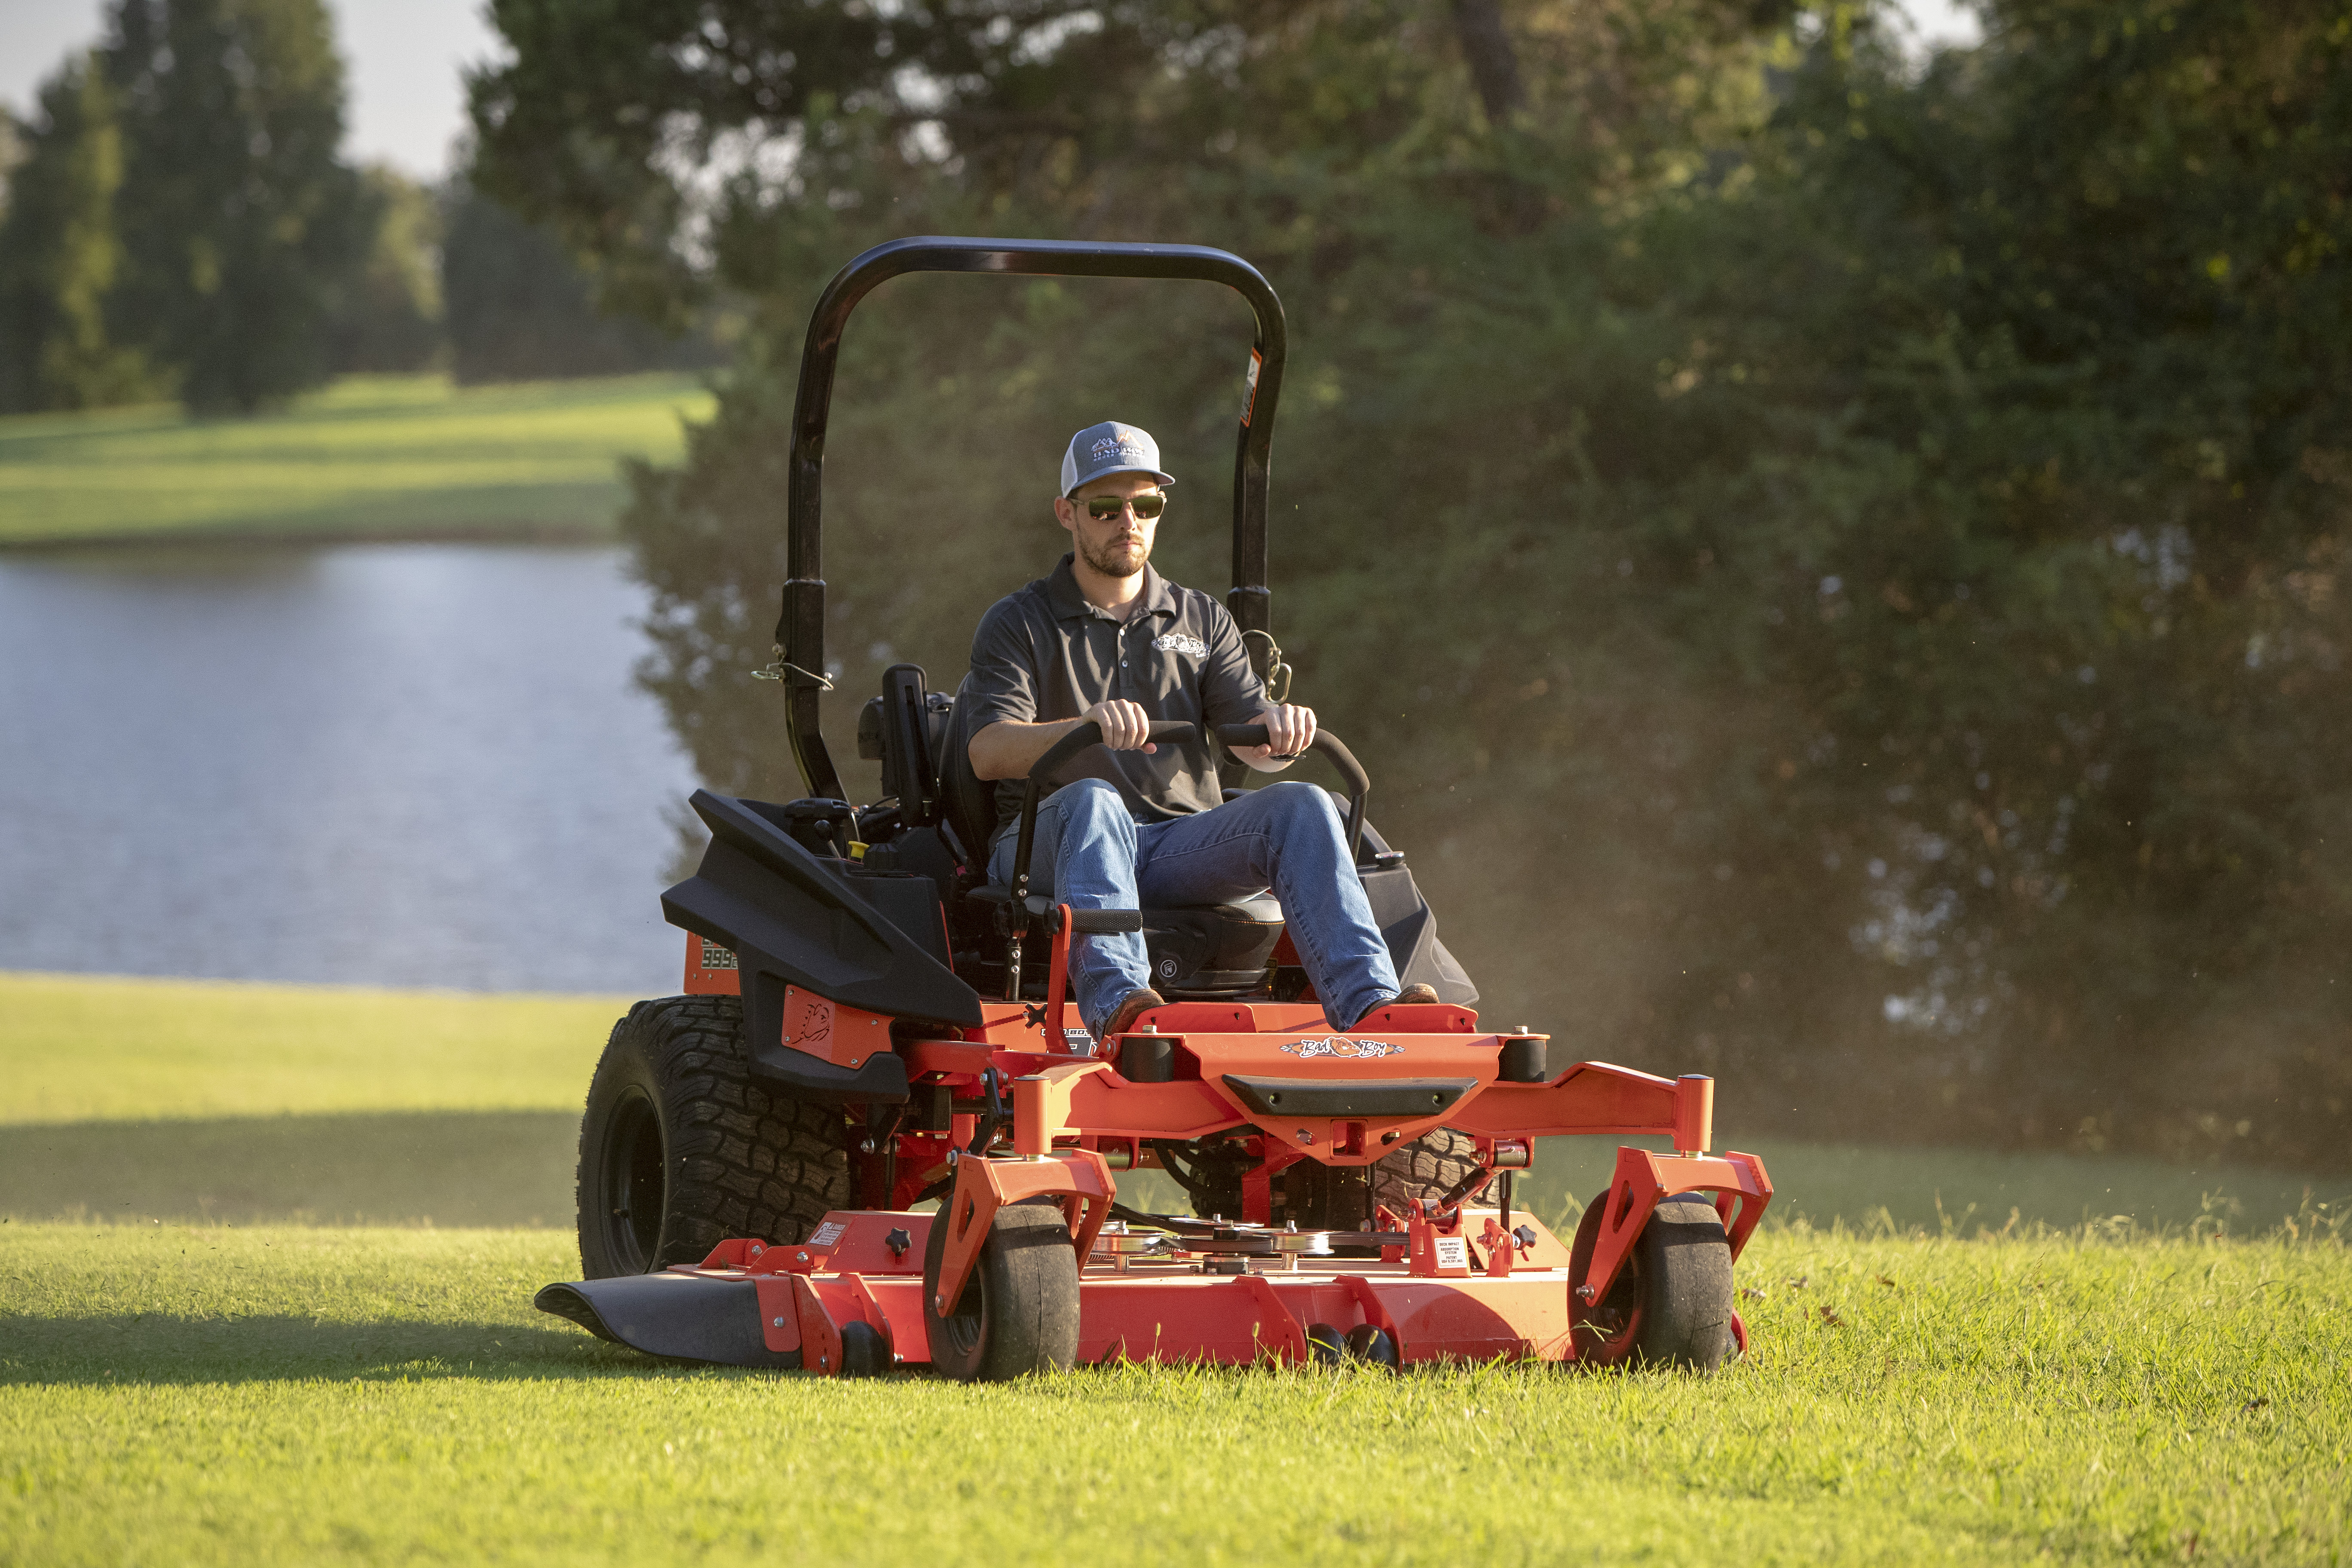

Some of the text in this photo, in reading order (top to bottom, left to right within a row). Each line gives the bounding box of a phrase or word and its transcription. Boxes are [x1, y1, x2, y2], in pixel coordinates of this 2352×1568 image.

[1093, 448, 1120, 458] BAD
[1300, 1039, 1387, 1058] Bad Boy
